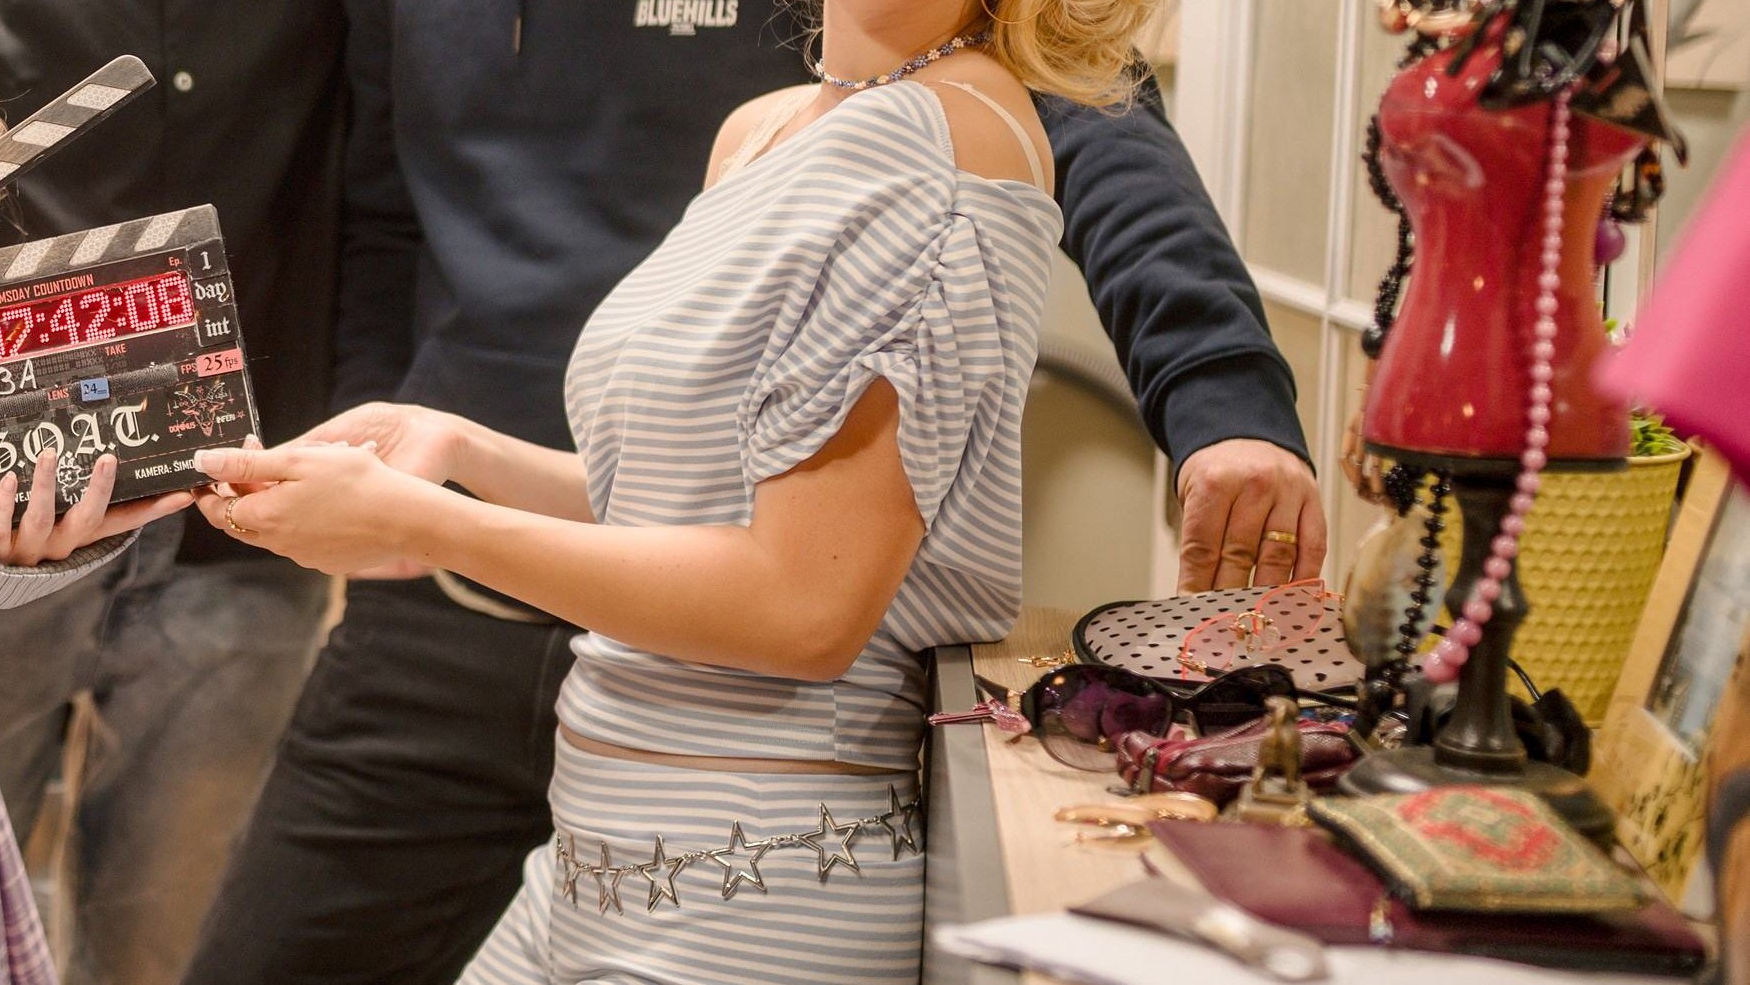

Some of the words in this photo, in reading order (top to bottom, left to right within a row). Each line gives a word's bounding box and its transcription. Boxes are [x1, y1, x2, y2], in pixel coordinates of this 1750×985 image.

[169, 256, 183, 267] Ep.
[34, 274, 94, 297] COUNTDOWN
[194, 281, 230, 303] day
[204, 317, 231, 337] int
[104, 343, 127, 356] TAKE
[180, 363, 197, 376] FPS
[204, 354, 223, 372] 25
[224, 356, 239, 369] fps
[47, 388, 70, 401] LENS
[134, 463, 172, 480] KAMERA:
